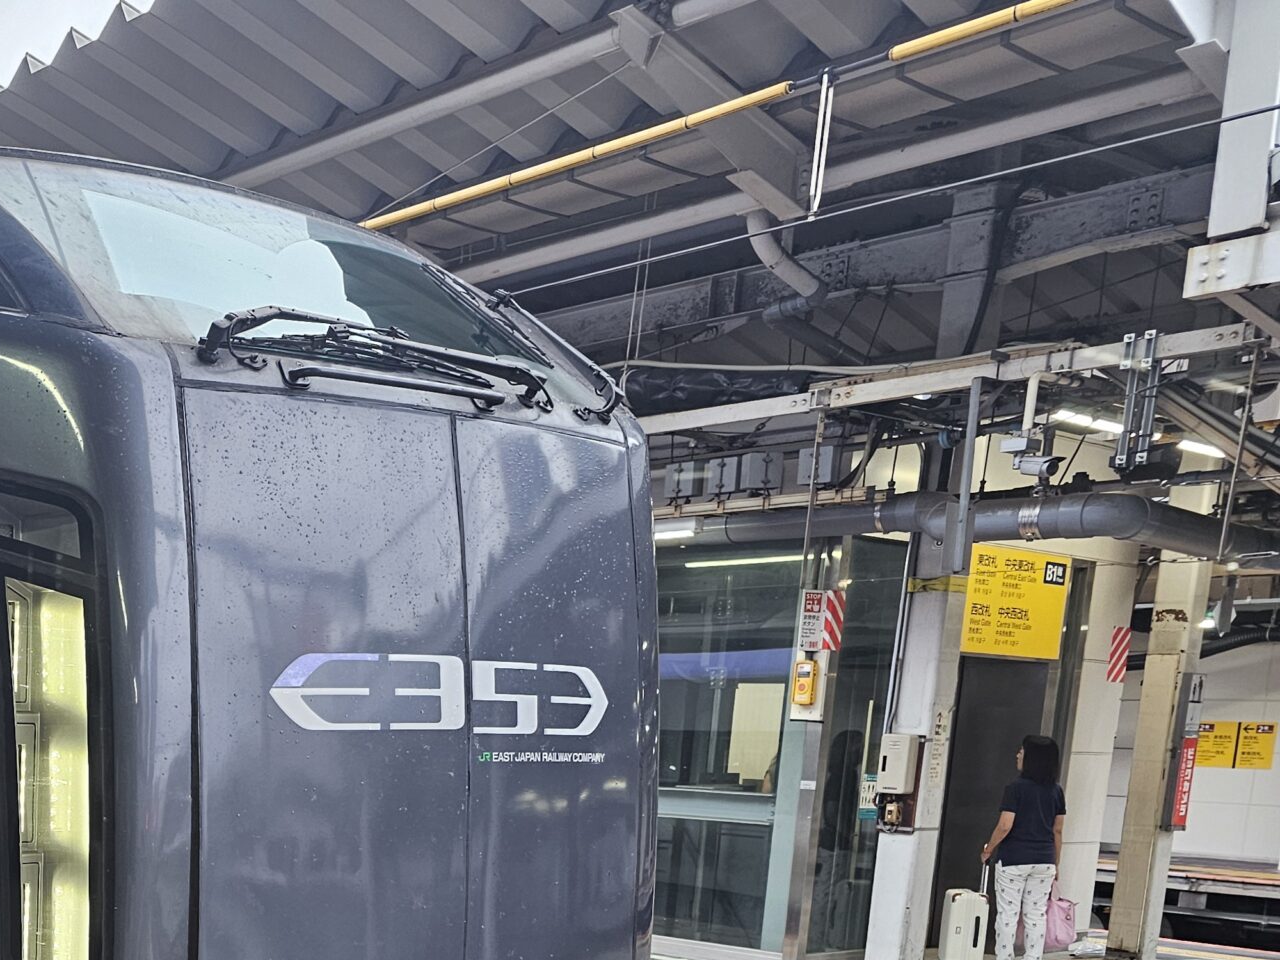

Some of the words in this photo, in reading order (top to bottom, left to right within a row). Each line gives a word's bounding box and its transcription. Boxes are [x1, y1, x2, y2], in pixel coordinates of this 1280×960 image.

[269, 652, 609, 736] E353
[479, 752, 491, 762] JR
[492, 752, 515, 762] EAST
[515, 752, 541, 762] JAPAN
[542, 752, 573, 763] RAILWAY
[572, 753, 606, 763] COMPANY
